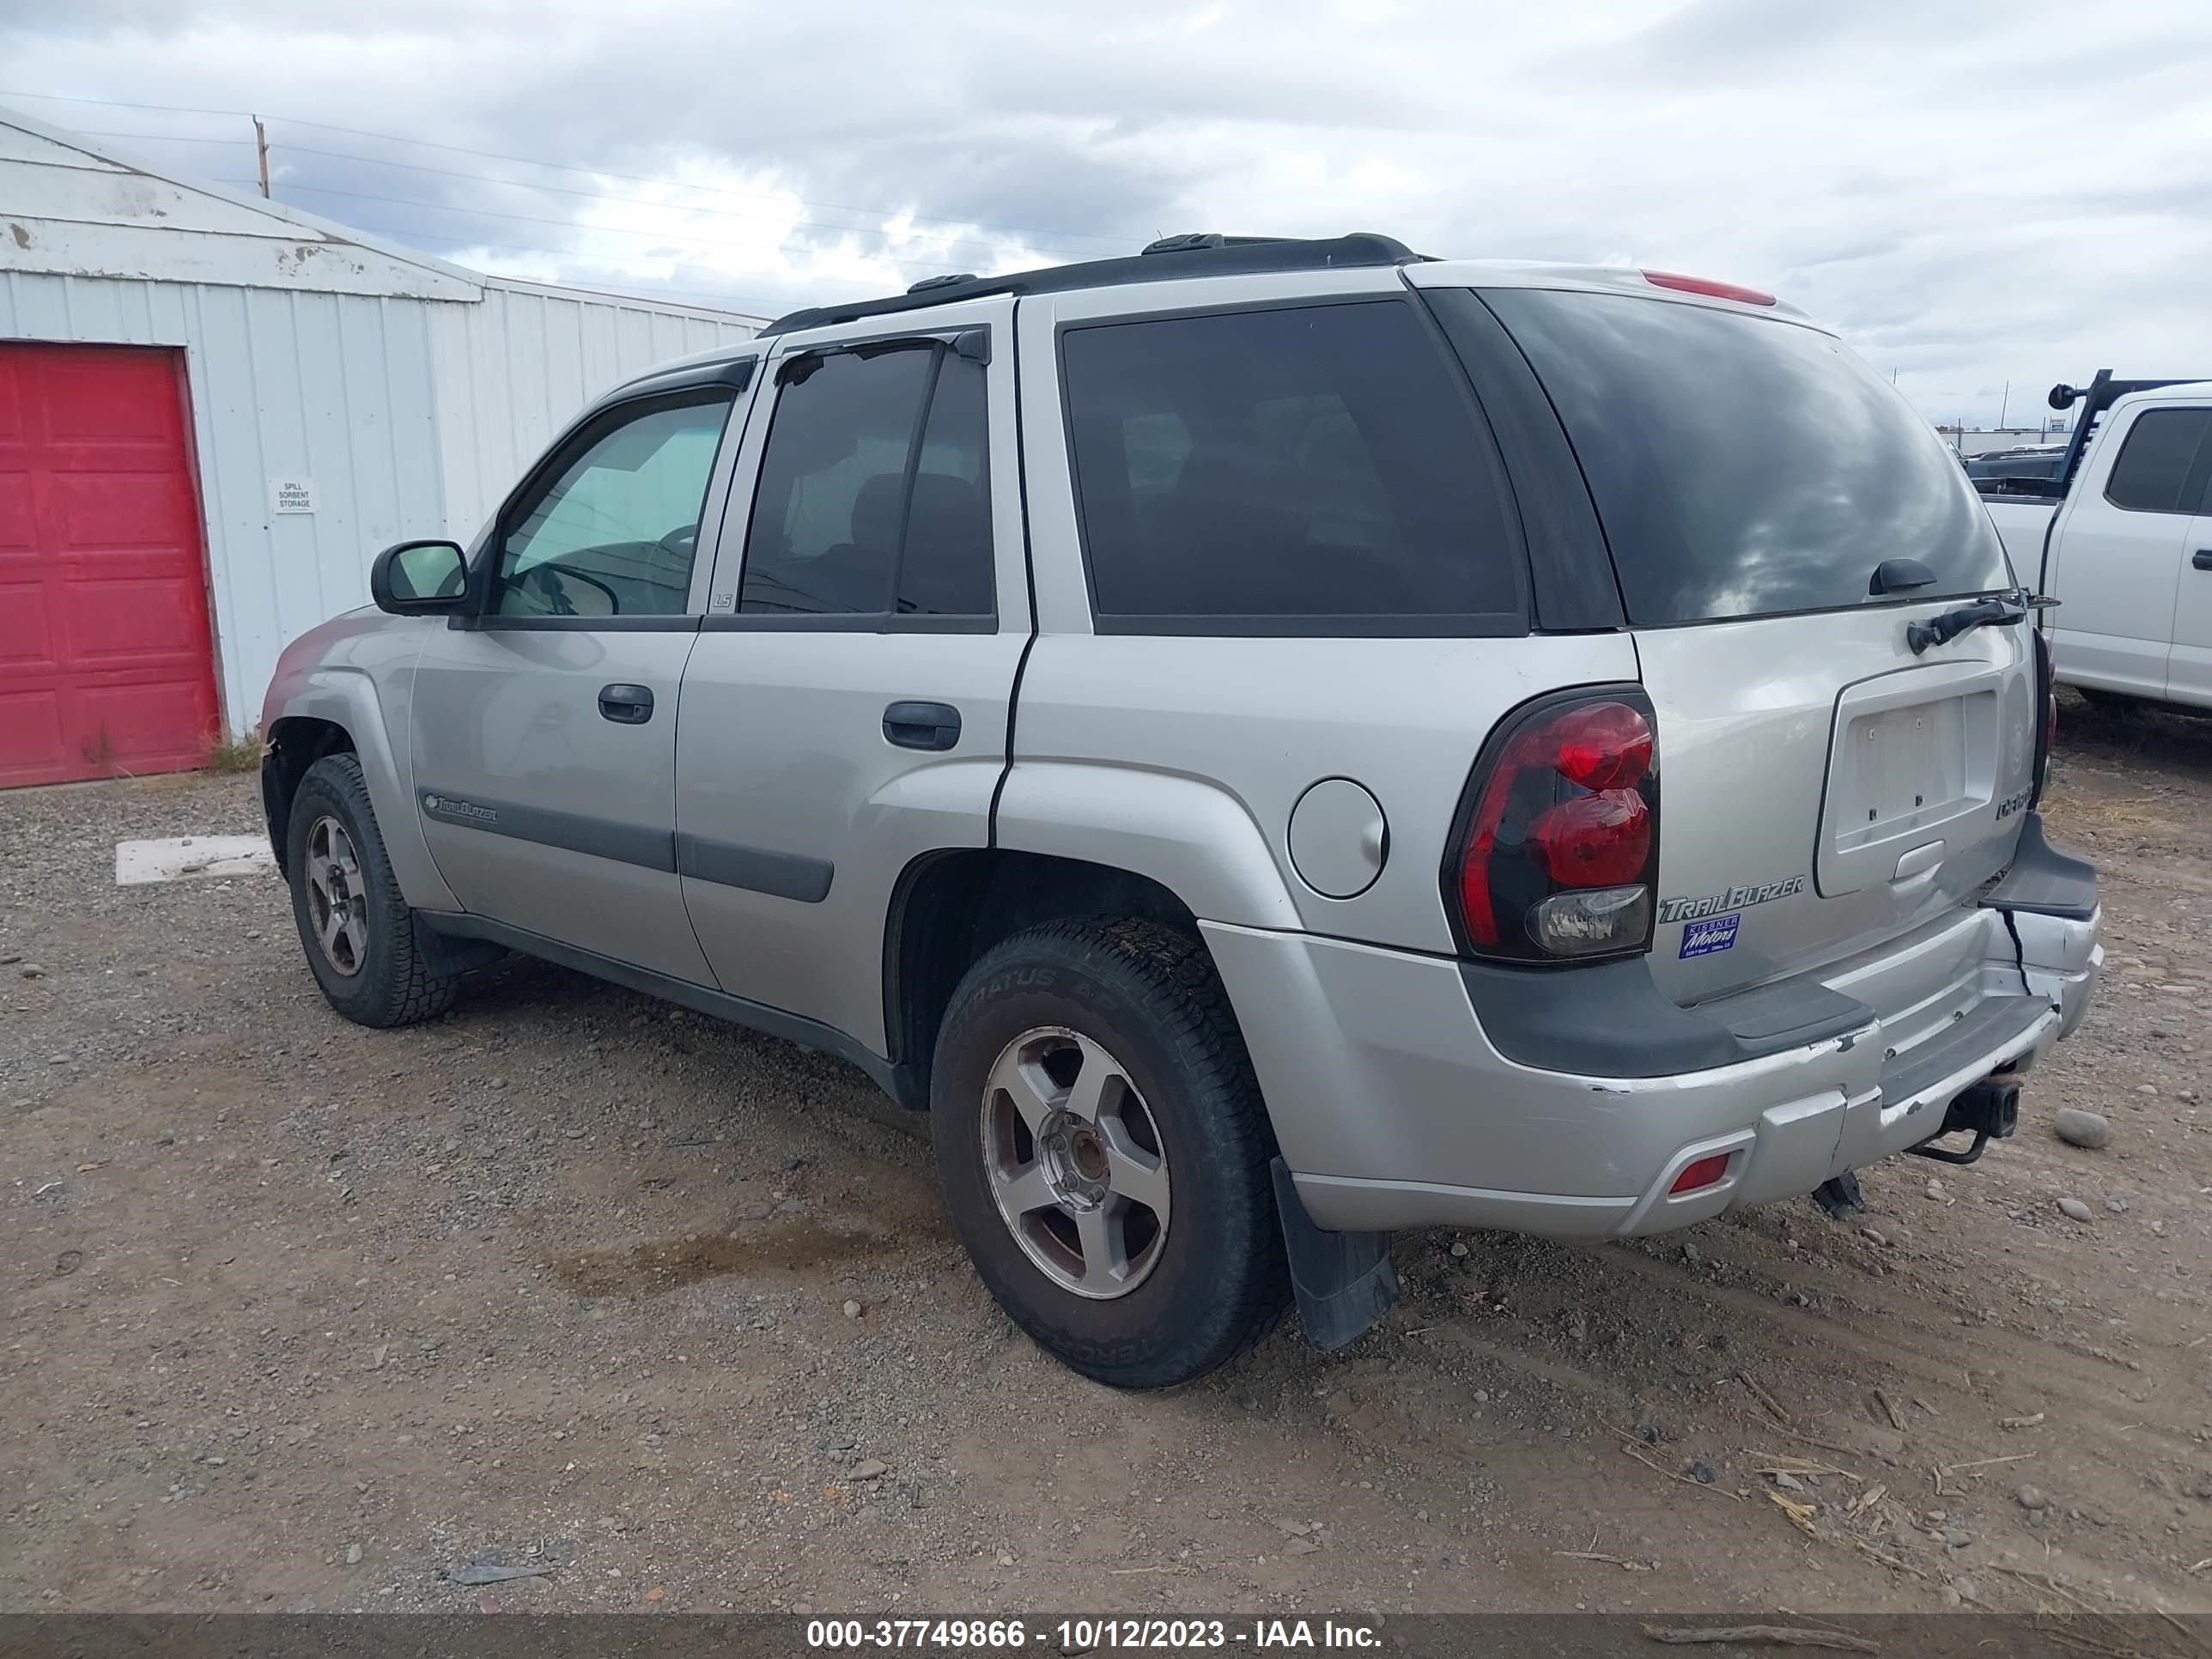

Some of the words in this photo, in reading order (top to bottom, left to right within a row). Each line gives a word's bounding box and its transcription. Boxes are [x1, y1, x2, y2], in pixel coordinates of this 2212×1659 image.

[714, 593, 732, 608] LS
[1659, 875, 1806, 924] TRAILBLAZER
[1689, 918, 1738, 934] KISSNER
[1683, 928, 1736, 951] Motors
